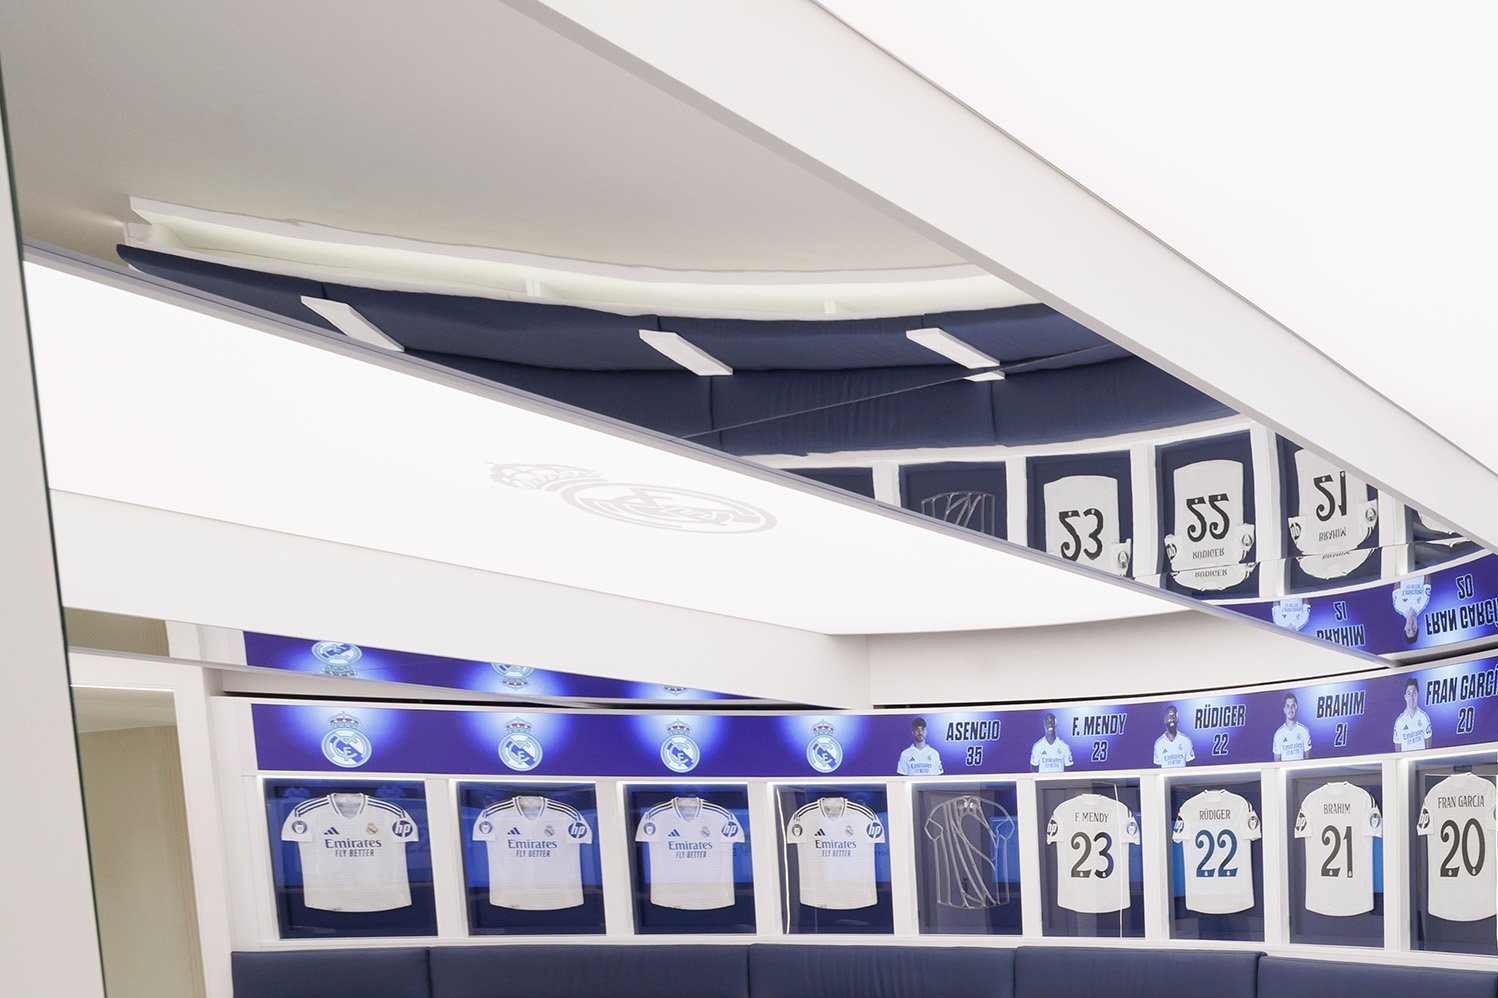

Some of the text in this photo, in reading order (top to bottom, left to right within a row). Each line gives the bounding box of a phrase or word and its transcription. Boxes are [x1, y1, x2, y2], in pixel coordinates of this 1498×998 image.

[1425, 676, 1457, 706] FRAN
[1316, 691, 1366, 719] BRAHIM
[1072, 713, 1127, 737] F. MENDY
[1194, 704, 1246, 729] RÜDIGER
[1457, 707, 1475, 734] 20
[946, 720, 1001, 741] ASENCIO
[1334, 722, 1347, 747] 21
[1092, 741, 1108, 761] 23
[1212, 734, 1229, 756] 22
[966, 746, 982, 765] 35
[1323, 803, 1351, 815] BRAHIM
[1438, 793, 1485, 809] FRAN GARCÍA
[1075, 811, 1109, 823] F. MENDY
[1199, 808, 1231, 820] RÜDIGER
[394, 820, 412, 838] hp
[569, 822, 586, 839] hp
[722, 821, 738, 837] hp
[867, 822, 881, 839] hp
[324, 838, 382, 848] Emirates
[508, 839, 557, 849] Emirates
[668, 841, 713, 850] Emirates
[815, 839, 857, 849] Emirates
[1321, 825, 1353, 878] 21
[1440, 817, 1486, 877] 20
[349, 849, 374, 857] BETTER
[676, 851, 707, 859] FLY BETTER
[1070, 831, 1114, 878] 23
[1195, 829, 1238, 878] 22
